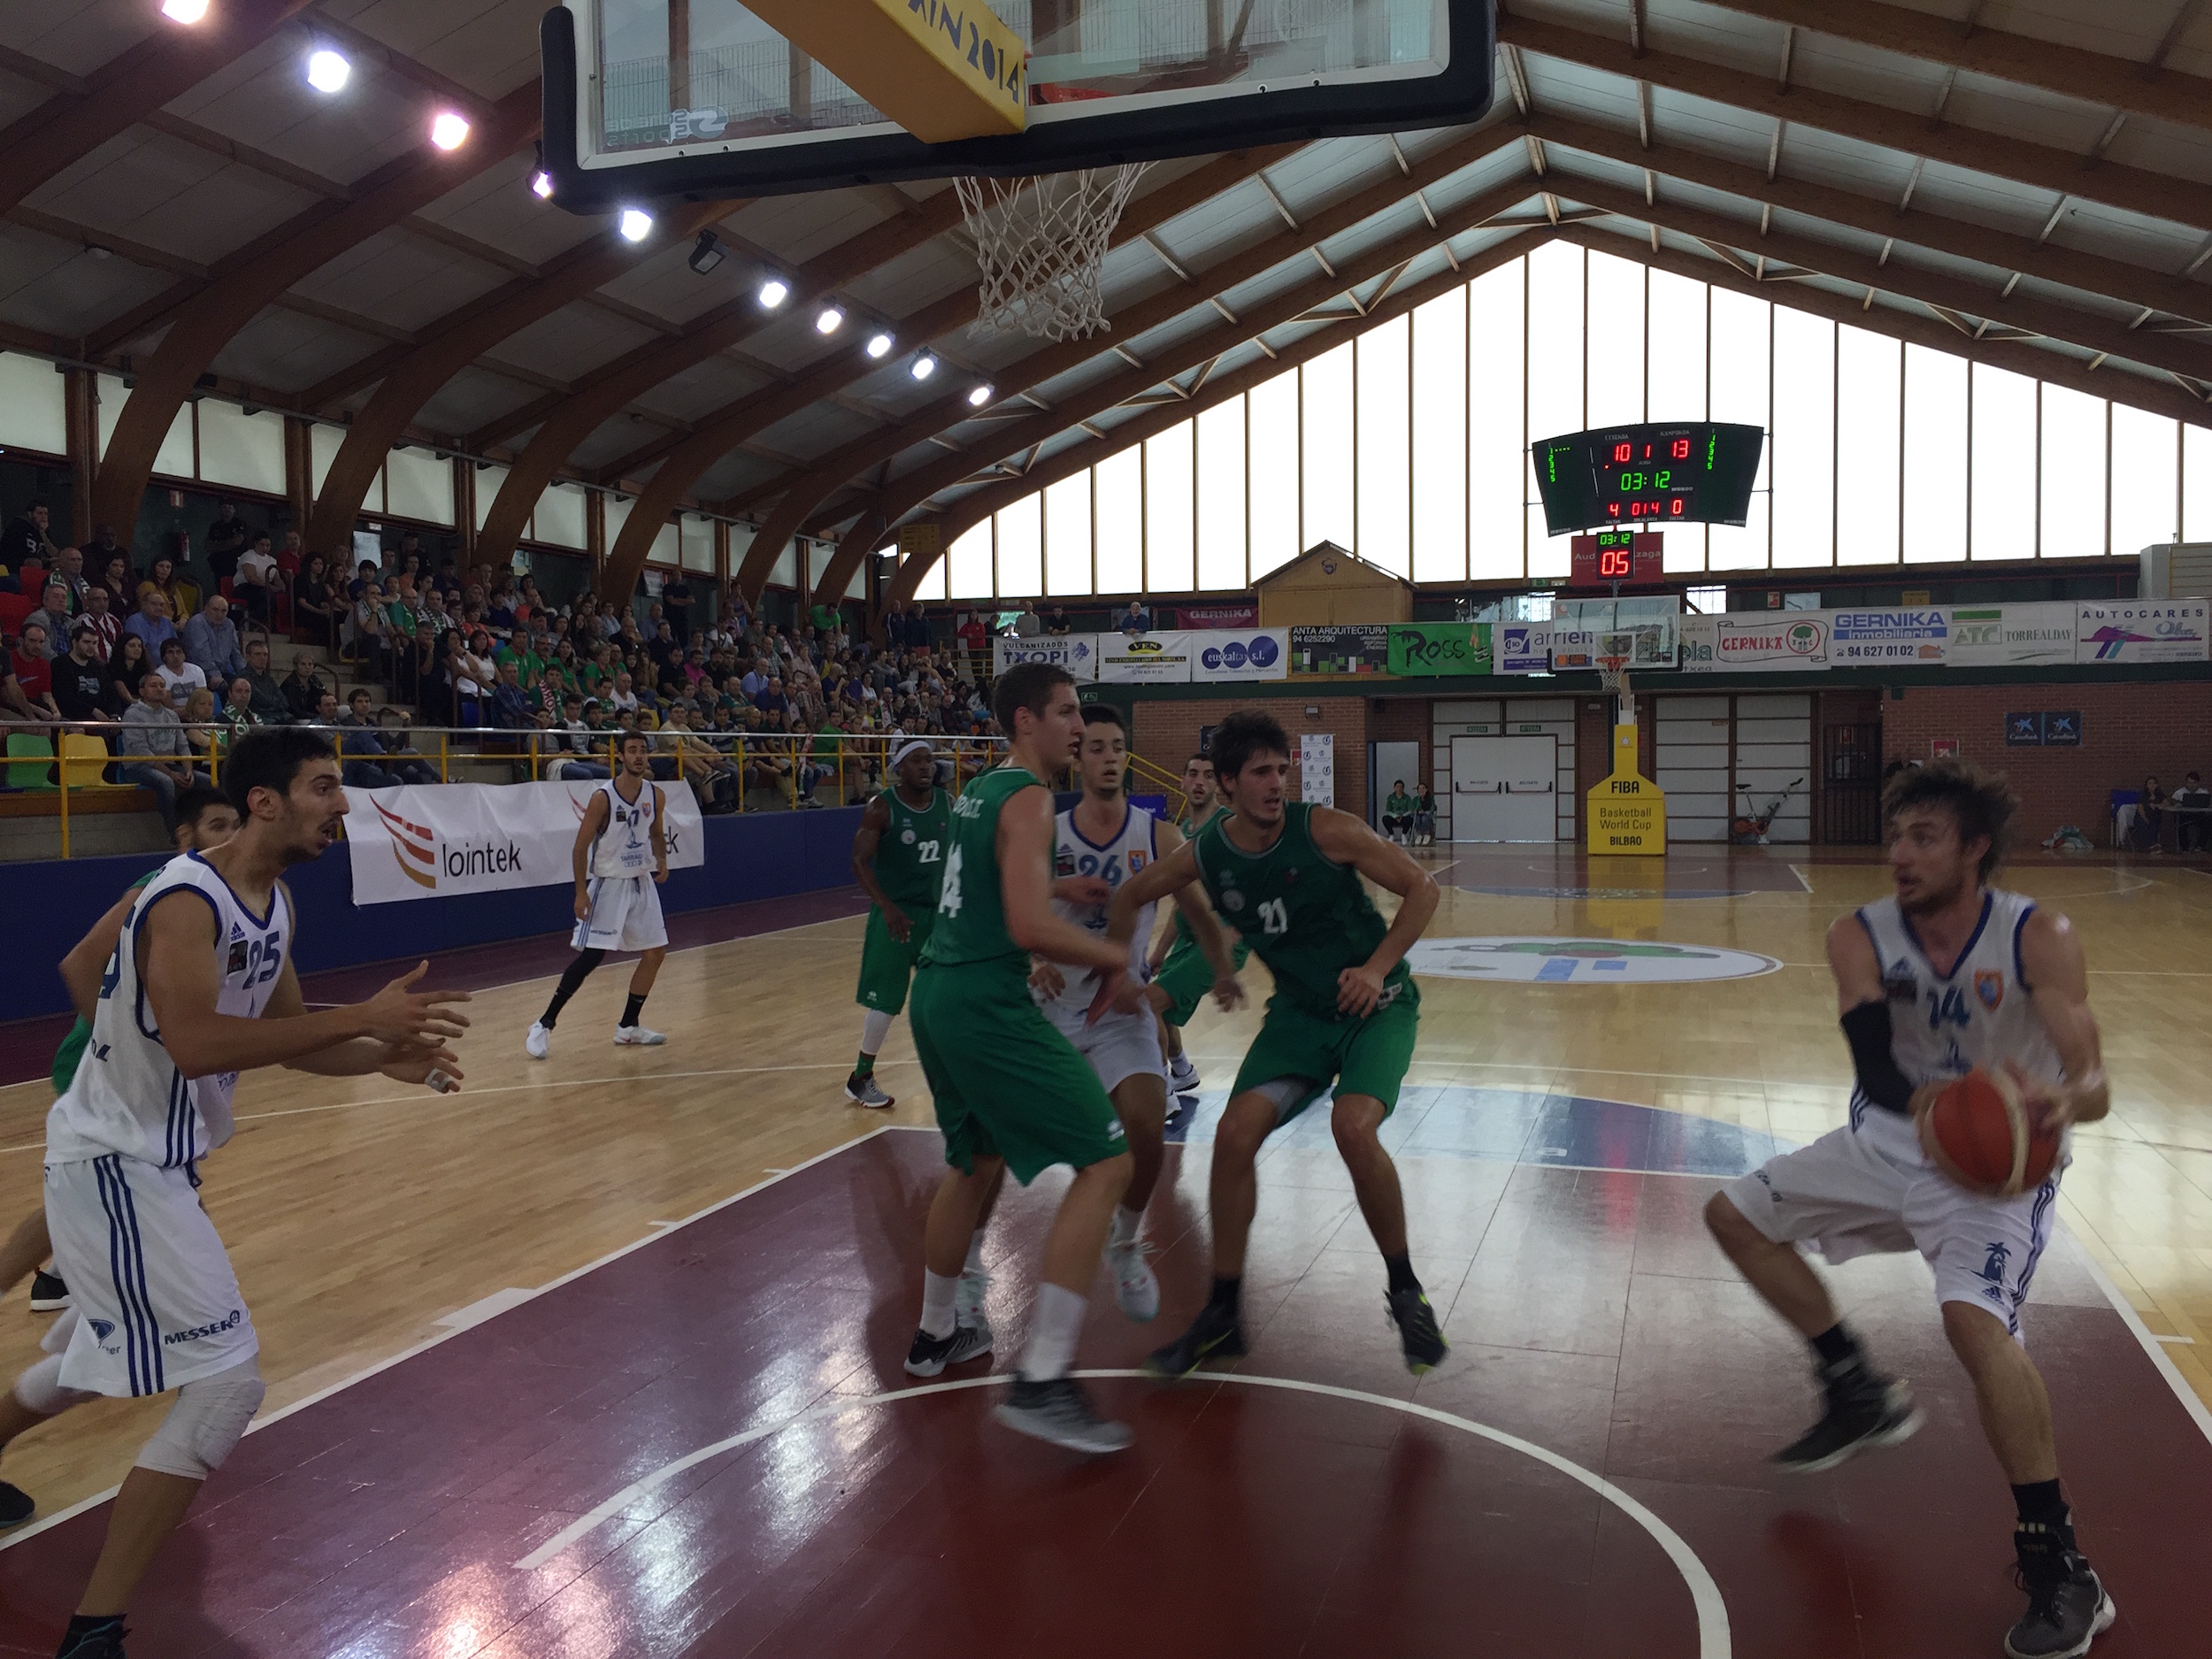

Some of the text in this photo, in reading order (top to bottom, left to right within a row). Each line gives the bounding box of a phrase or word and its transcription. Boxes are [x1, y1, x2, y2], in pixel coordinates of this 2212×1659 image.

[1614, 443, 1632, 462] 10
[1645, 444, 1651, 458] 1
[1671, 439, 1690, 459] 13
[1620, 471, 1671, 492] 03:12
[1609, 503, 1620, 518] 4
[1672, 499, 1683, 515] 0
[1600, 533, 1631, 545] 03:12
[1601, 550, 1630, 575] 05
[1189, 608, 1252, 619] GERNIKA
[1835, 611, 1945, 627] GERNIKA
[2082, 609, 2203, 618] AUTOCARES
[1293, 626, 1388, 635] ANTA ARQUITECTURA
[1848, 628, 1932, 639] inmobiliaria
[2005, 629, 2071, 641] TORREALDAY
[1722, 637, 1784, 650] GERNIKA
[1003, 650, 1068, 664] TXOPI
[1847, 645, 1914, 657] 94 627 01 02
[1611, 781, 1640, 794] FIBA
[1600, 808, 1651, 818] Basketball
[1600, 819, 1651, 830] World Cup
[1610, 836, 1642, 846] BILBAO
[442, 839, 522, 878] lointek
[918, 840, 941, 864] 22
[242, 931, 280, 991] 25
[164, 1321, 234, 1346] MESSER
